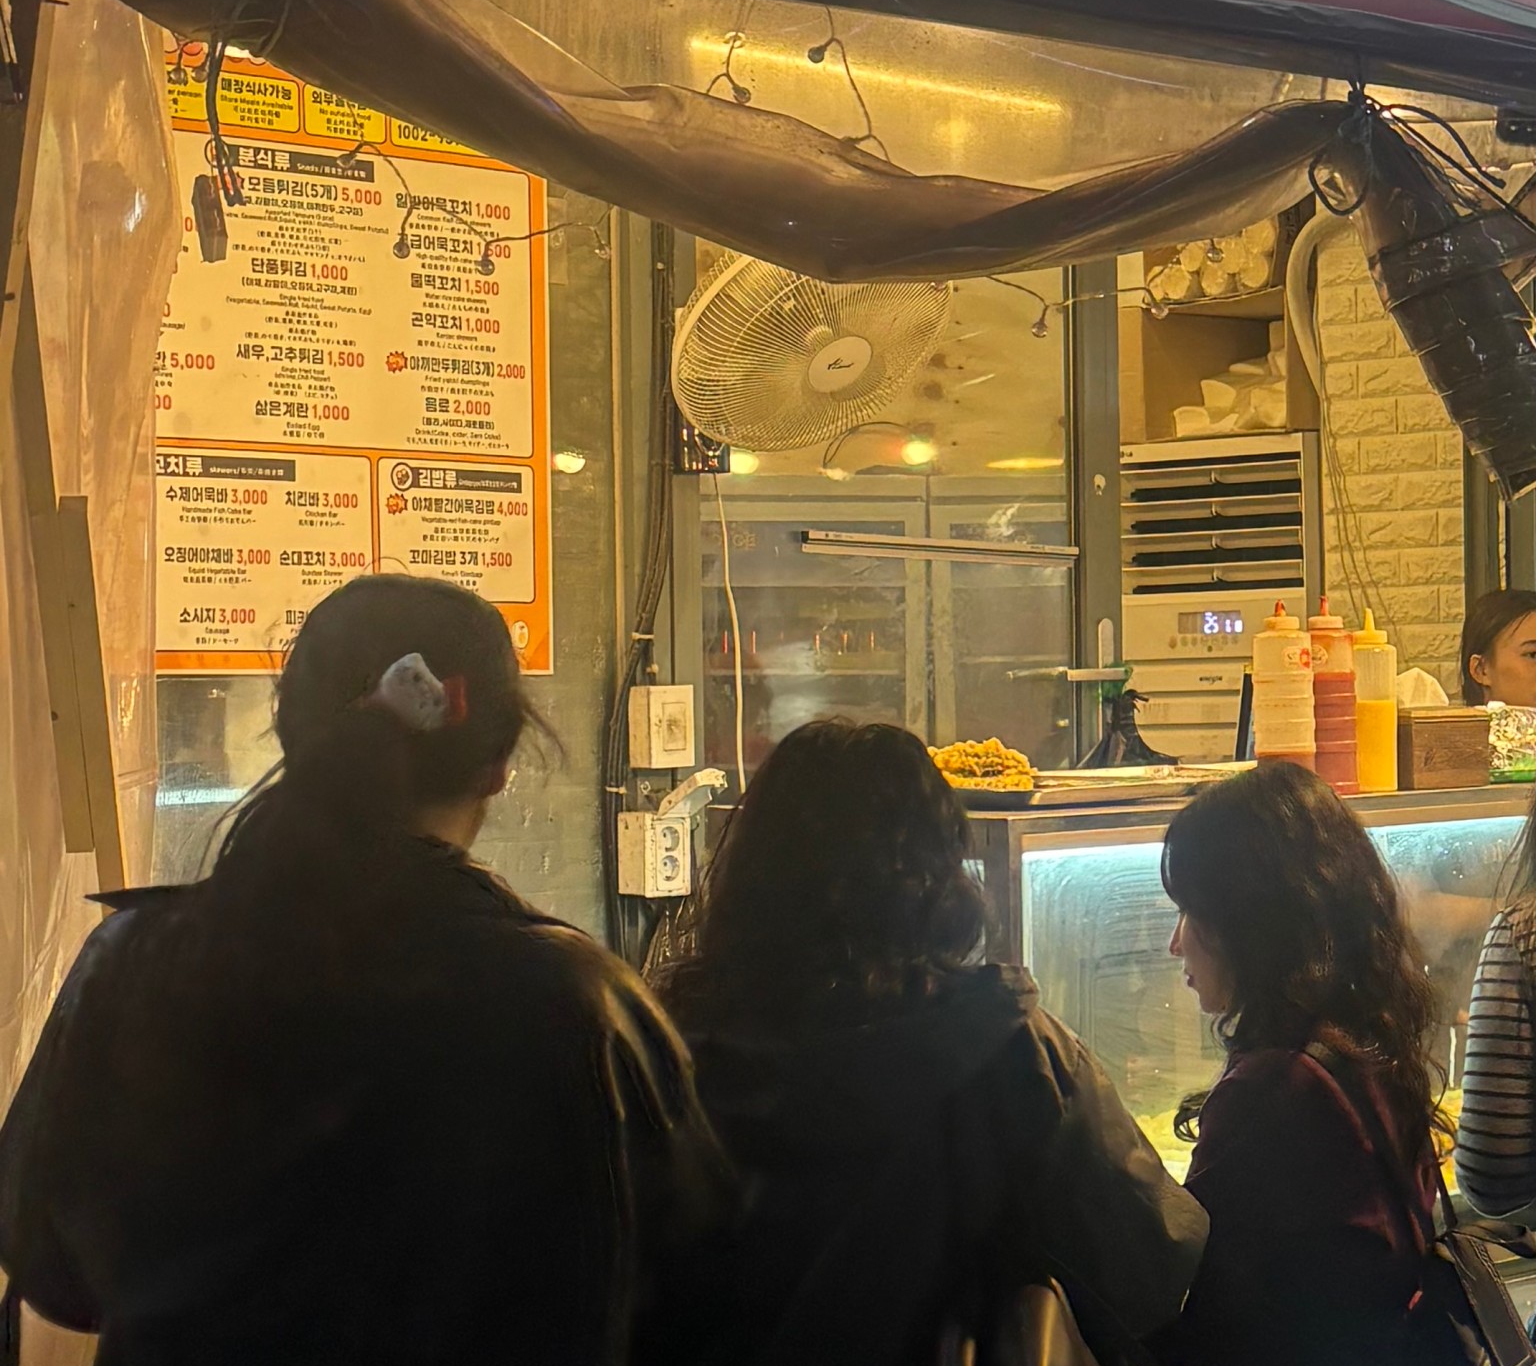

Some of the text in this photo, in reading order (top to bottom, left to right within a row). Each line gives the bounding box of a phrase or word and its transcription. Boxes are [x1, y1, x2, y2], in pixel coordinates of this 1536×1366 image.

[220, 77, 292, 101] 매장식사가능
[238, 147, 291, 170] 분식류
[341, 187, 382, 206] 5,000
[475, 202, 511, 221] 1,000
[398, 233, 473, 255] 급어묵꼬치
[251, 257, 348, 281] 단품튀김 1,000
[465, 279, 500, 296] 1,500
[465, 318, 500, 334] 1,000
[170, 352, 215, 371] 5,000
[236, 343, 365, 368] 새우,고추튀김 1,500
[497, 363, 526, 379] 2,000
[255, 400, 350, 422] 삶은계란 1,000
[425, 397, 491, 416] 음료 2,000
[418, 469, 457, 489] 김밥류
[165, 485, 268, 505] 수제어묵바 3,000
[285, 490, 358, 509] 치킨바 3,000
[497, 500, 528, 516] 4,000
[164, 546, 271, 565] 오징어야채바 3,000
[279, 549, 366, 568] 순대꼬치 3,000
[409, 549, 513, 568] 꼬마김밥 3개 1,500
[179, 607, 256, 625] 소시지 3,000
